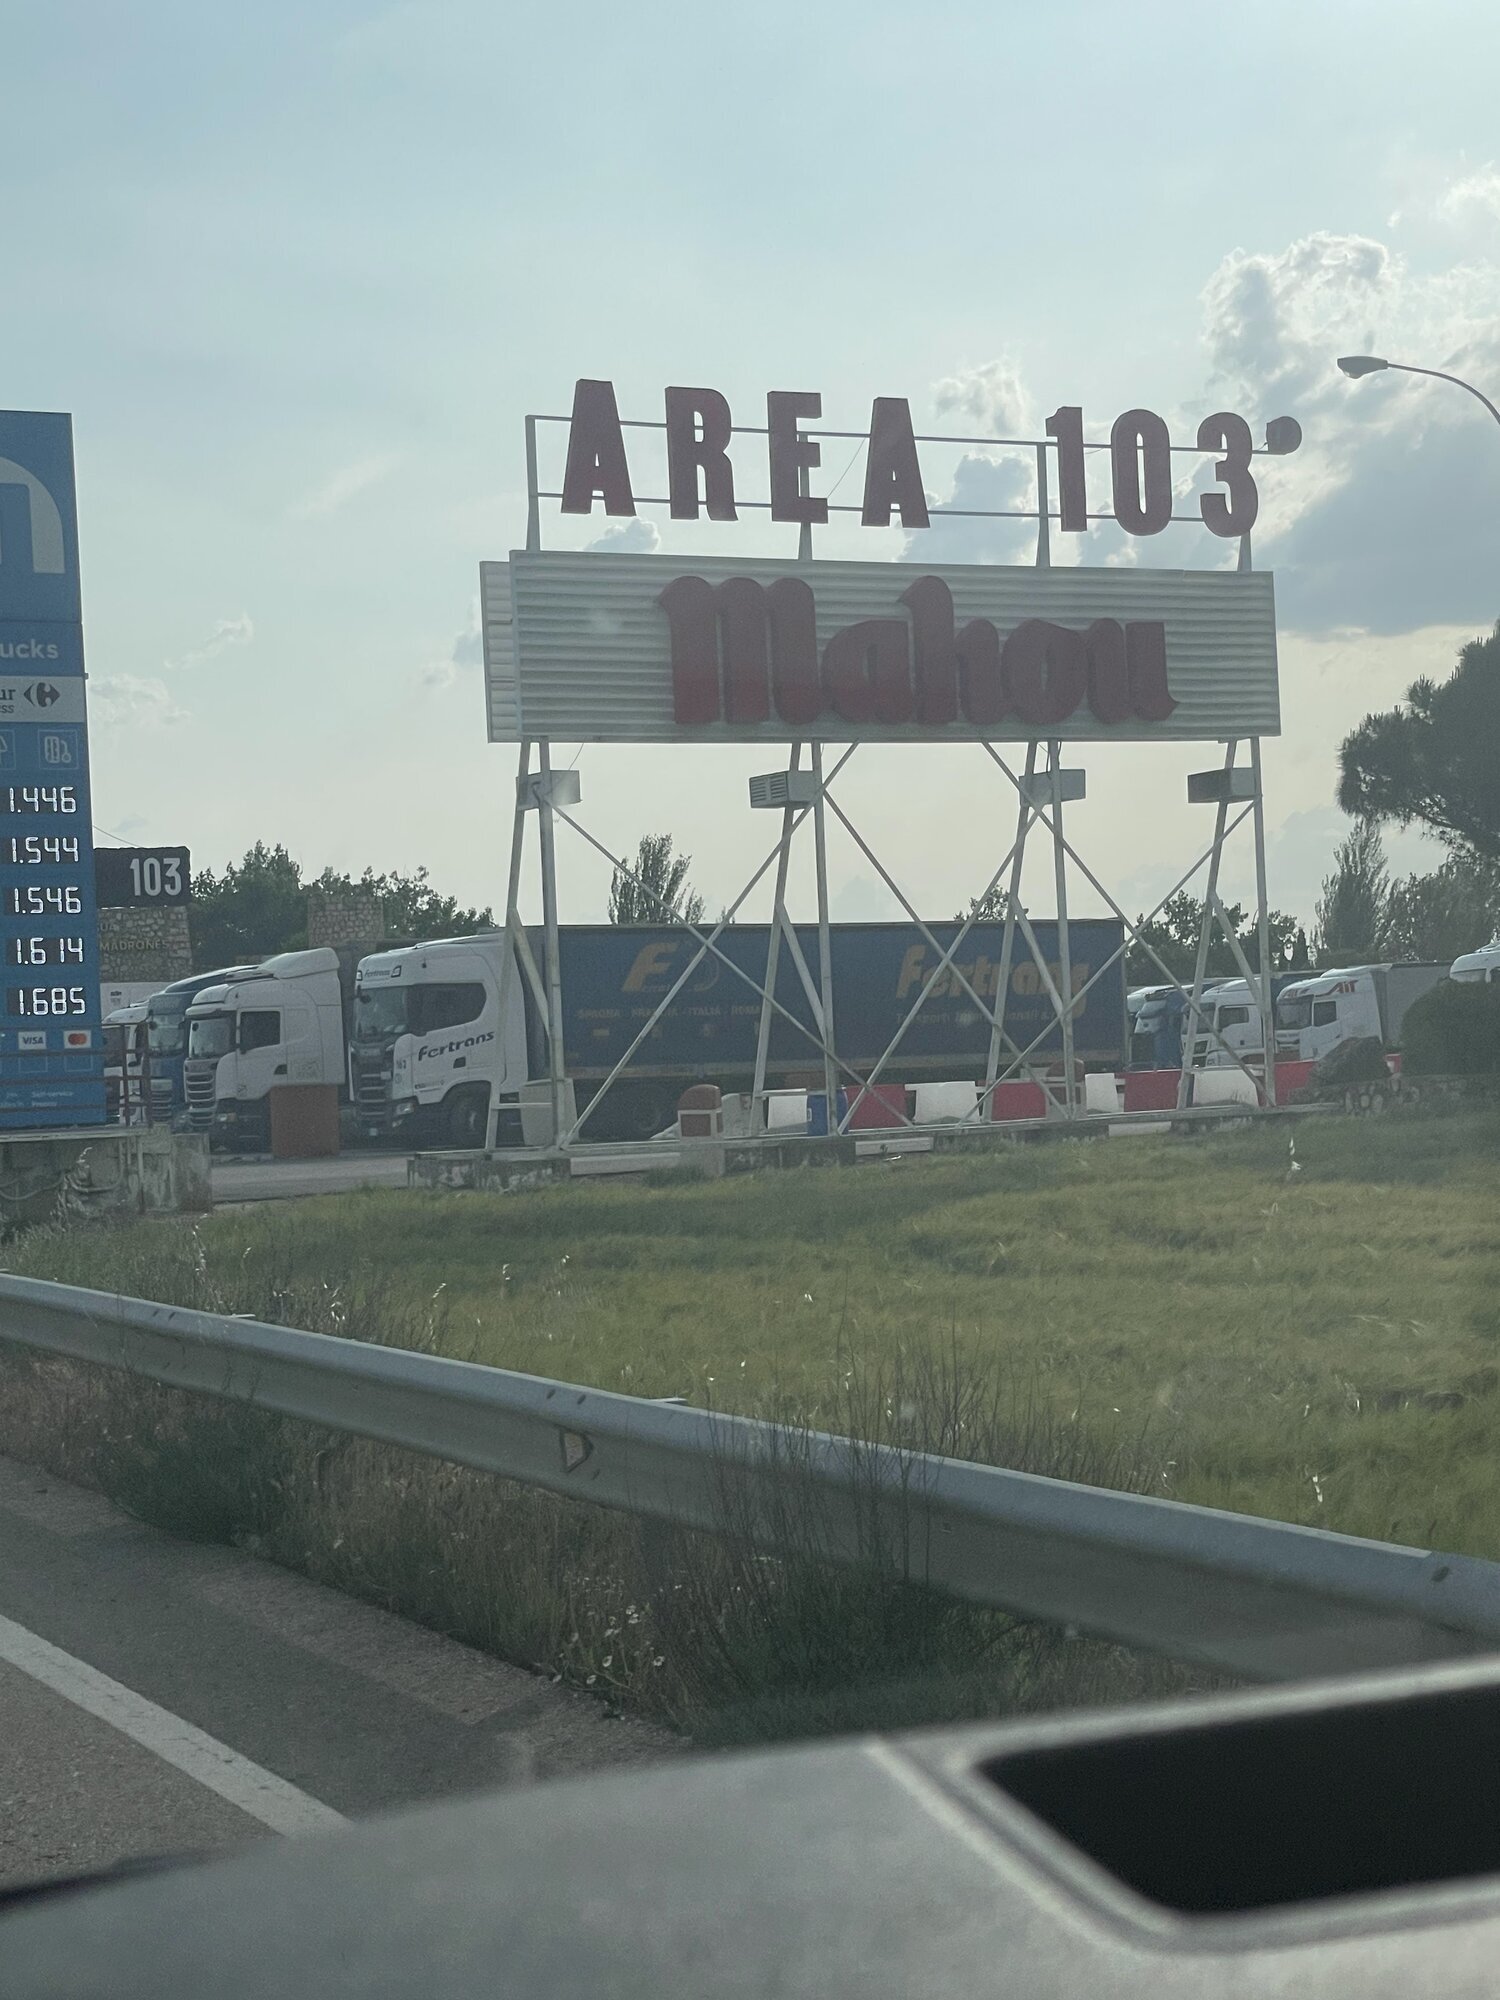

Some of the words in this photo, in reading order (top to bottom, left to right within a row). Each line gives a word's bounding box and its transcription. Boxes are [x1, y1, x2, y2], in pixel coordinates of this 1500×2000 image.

[560, 379, 930, 528] AREA
[657, 575, 1179, 725] Mahou
[9, 786, 77, 813] 1.446
[11, 836, 79, 864] 1.544
[130, 857, 182, 896] 103
[14, 886, 82, 914] 1.546
[16, 937, 84, 965] 1.614
[19, 987, 86, 1015] 1.685
[23, 1036, 43, 1044] VISA
